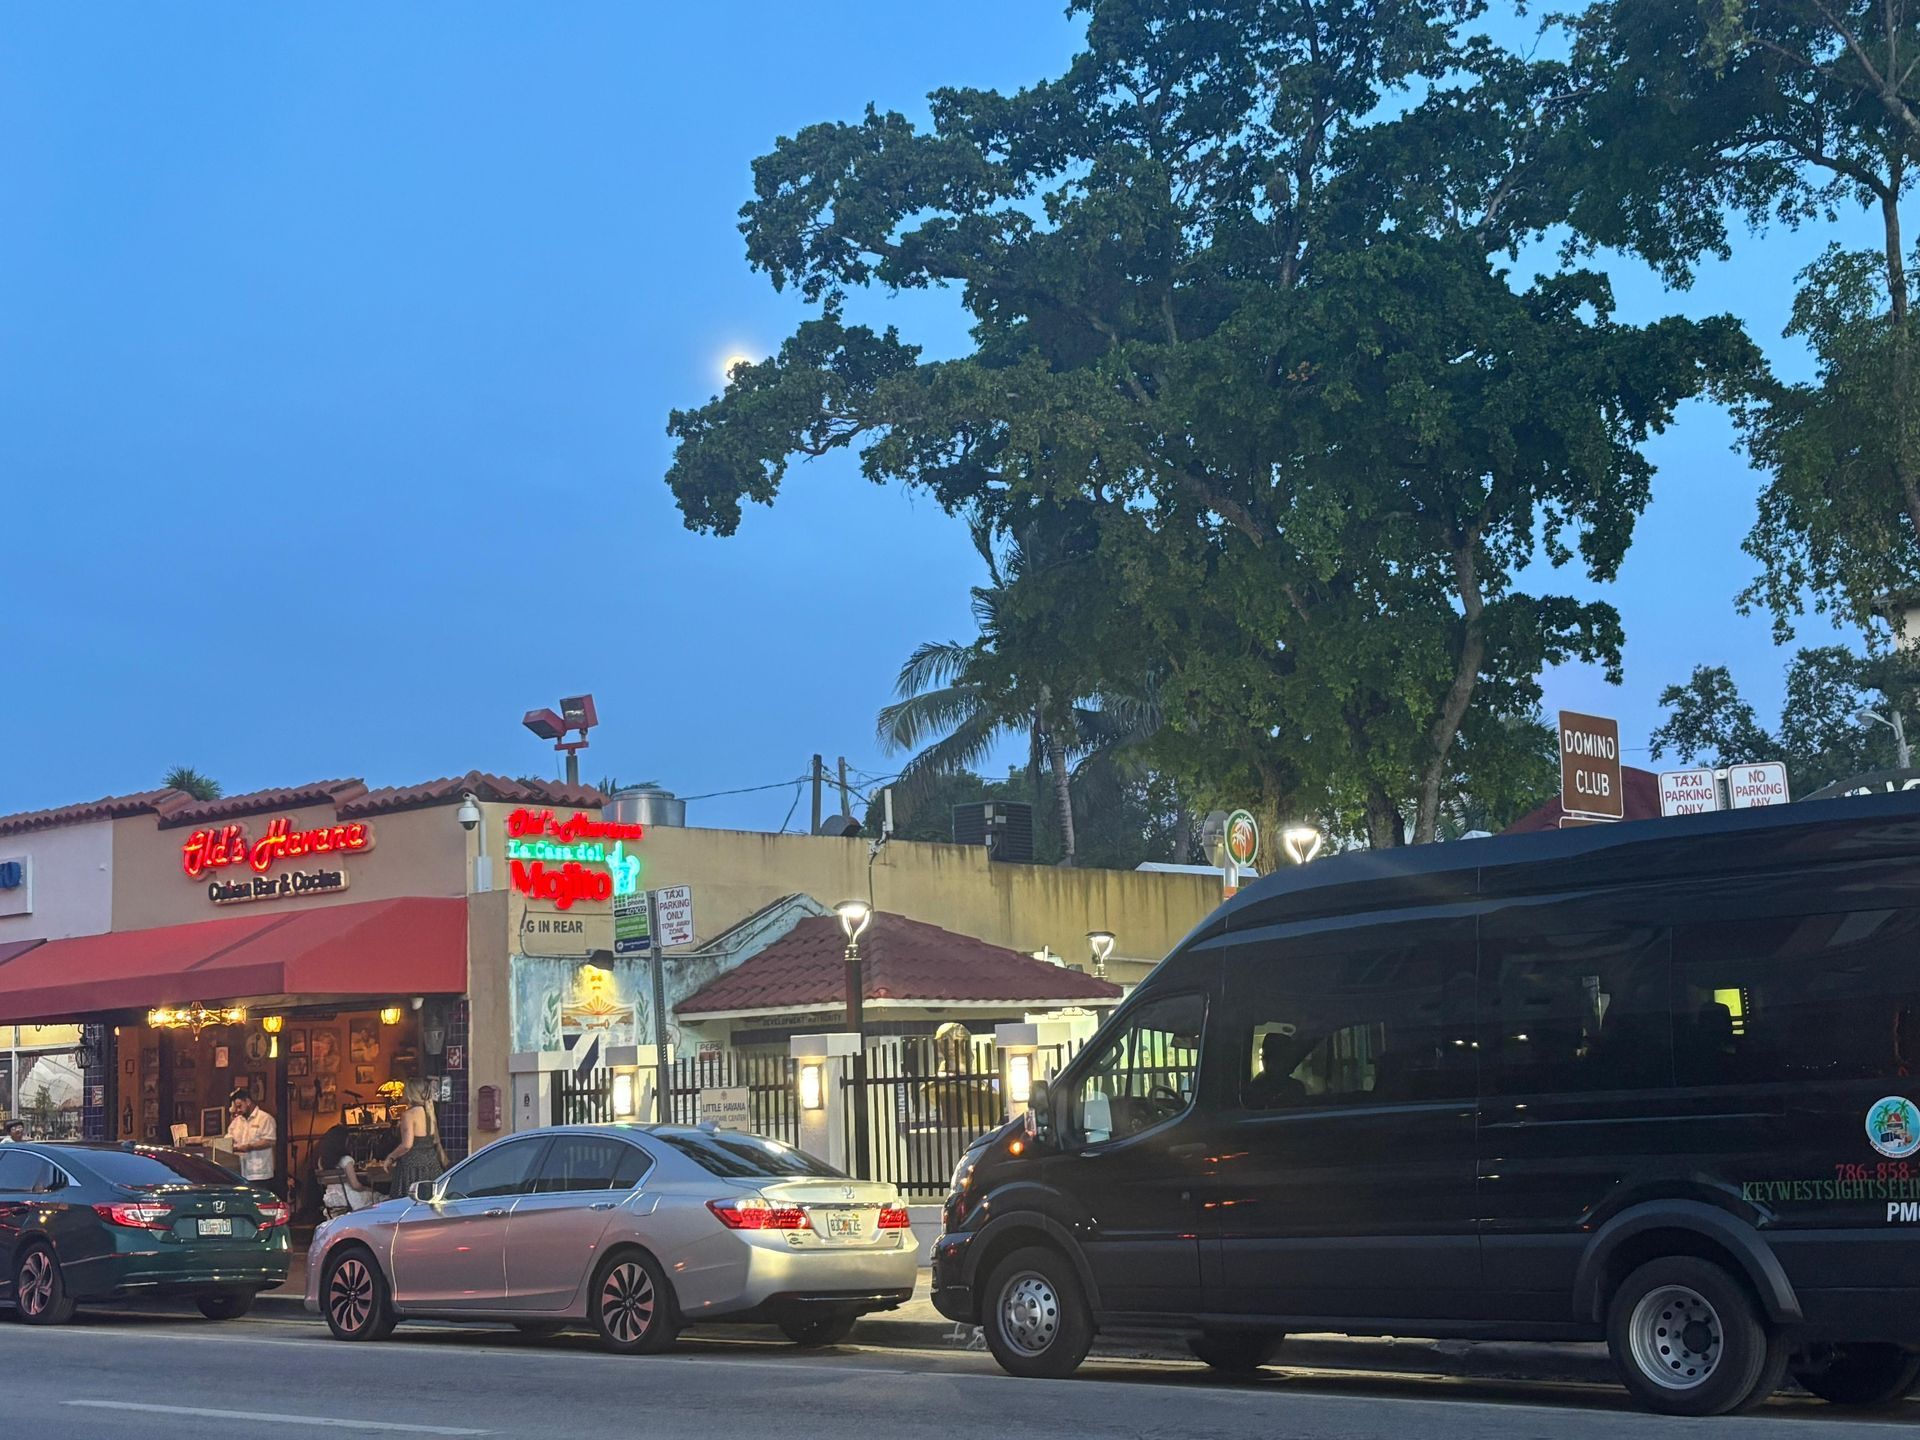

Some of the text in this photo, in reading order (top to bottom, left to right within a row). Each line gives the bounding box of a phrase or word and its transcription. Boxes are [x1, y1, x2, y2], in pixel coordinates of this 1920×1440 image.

[1565, 730, 1615, 760] DOMINO
[1576, 769, 1610, 797] CLUB
[1672, 775, 1702, 788] TAXI
[1748, 770, 1766, 783] NO
[1665, 790, 1713, 803] PARKING
[1735, 783, 1783, 797] PARKING
[1676, 804, 1704, 815] ONLY
[1750, 799, 1771, 808] ANY
[508, 808, 644, 843] Old's Havana
[183, 817, 368, 878] Old's Havana
[508, 839, 605, 861] La Casa del
[209, 870, 342, 901] Cuban Bar & Cocina
[510, 860, 612, 910] Mojito
[664, 889, 684, 900] TAXI
[660, 898, 690, 911] PARKING
[666, 910, 684, 921] ONLY
[538, 920, 550, 932] IN
[553, 920, 583, 933] REAR
[661, 920, 690, 930] TOW AWAY
[669, 927, 684, 935] ZONE
[703, 1102, 746, 1112] LITTLE HAVANA
[1835, 1162, 1920, 1183] 786-858-
[1887, 1202, 1920, 1222] PM
